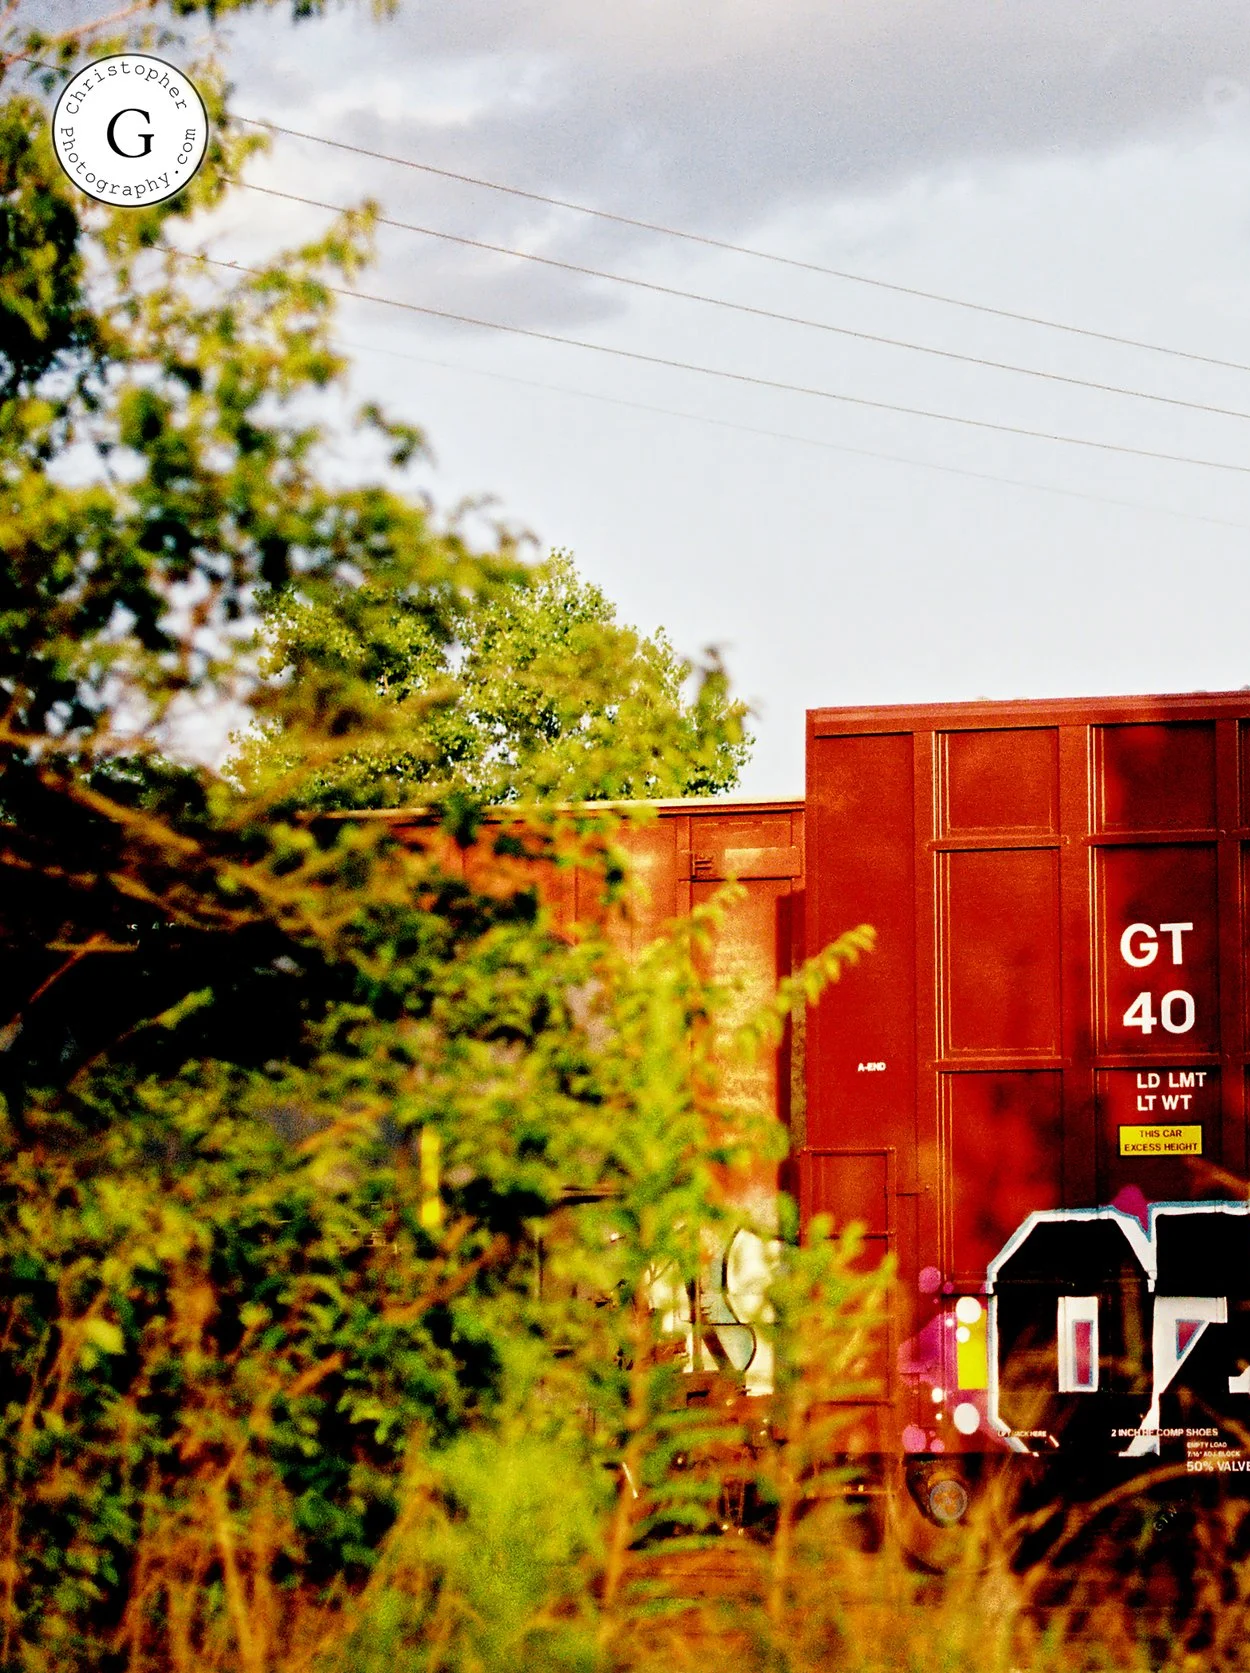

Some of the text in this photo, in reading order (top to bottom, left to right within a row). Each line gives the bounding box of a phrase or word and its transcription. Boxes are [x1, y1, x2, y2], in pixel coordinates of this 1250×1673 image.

[1120, 922, 1194, 968] GT
[1123, 990, 1195, 1035] 40
[857, 1061, 887, 1072] A-END
[1137, 1073, 1160, 1090] LD
[1168, 1071, 1207, 1089] LMT
[1137, 1095, 1155, 1112] LT
[1161, 1094, 1193, 1111] WT
[1139, 1129, 1183, 1138] THIS CAR
[1124, 1142, 1198, 1152] EXCESS HEIGHT
[1111, 1429, 1117, 1437] 2
[1156, 1428, 1184, 1437] COMP
[1186, 1428, 1219, 1437] SHOES
[1186, 1460, 1214, 1472] 50%
